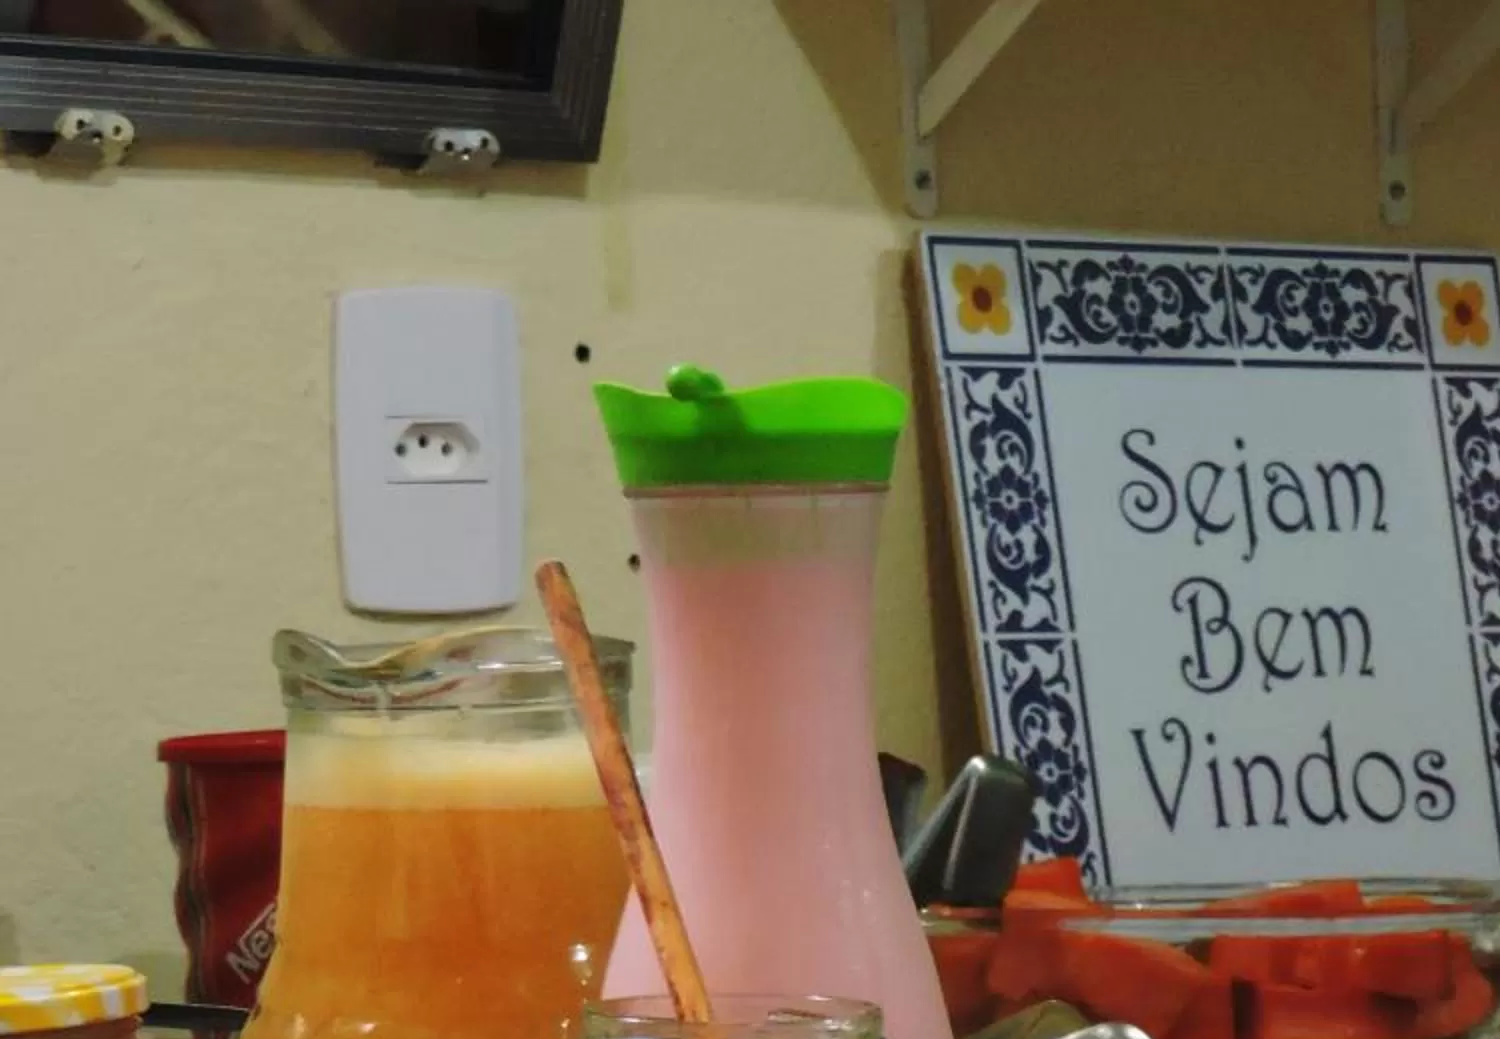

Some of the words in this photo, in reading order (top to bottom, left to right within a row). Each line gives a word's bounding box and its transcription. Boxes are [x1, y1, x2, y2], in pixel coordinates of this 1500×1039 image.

[1119, 427, 1388, 563] Sejam
[1171, 576, 1375, 694] Bem
[1129, 716, 1456, 833] Vindos
